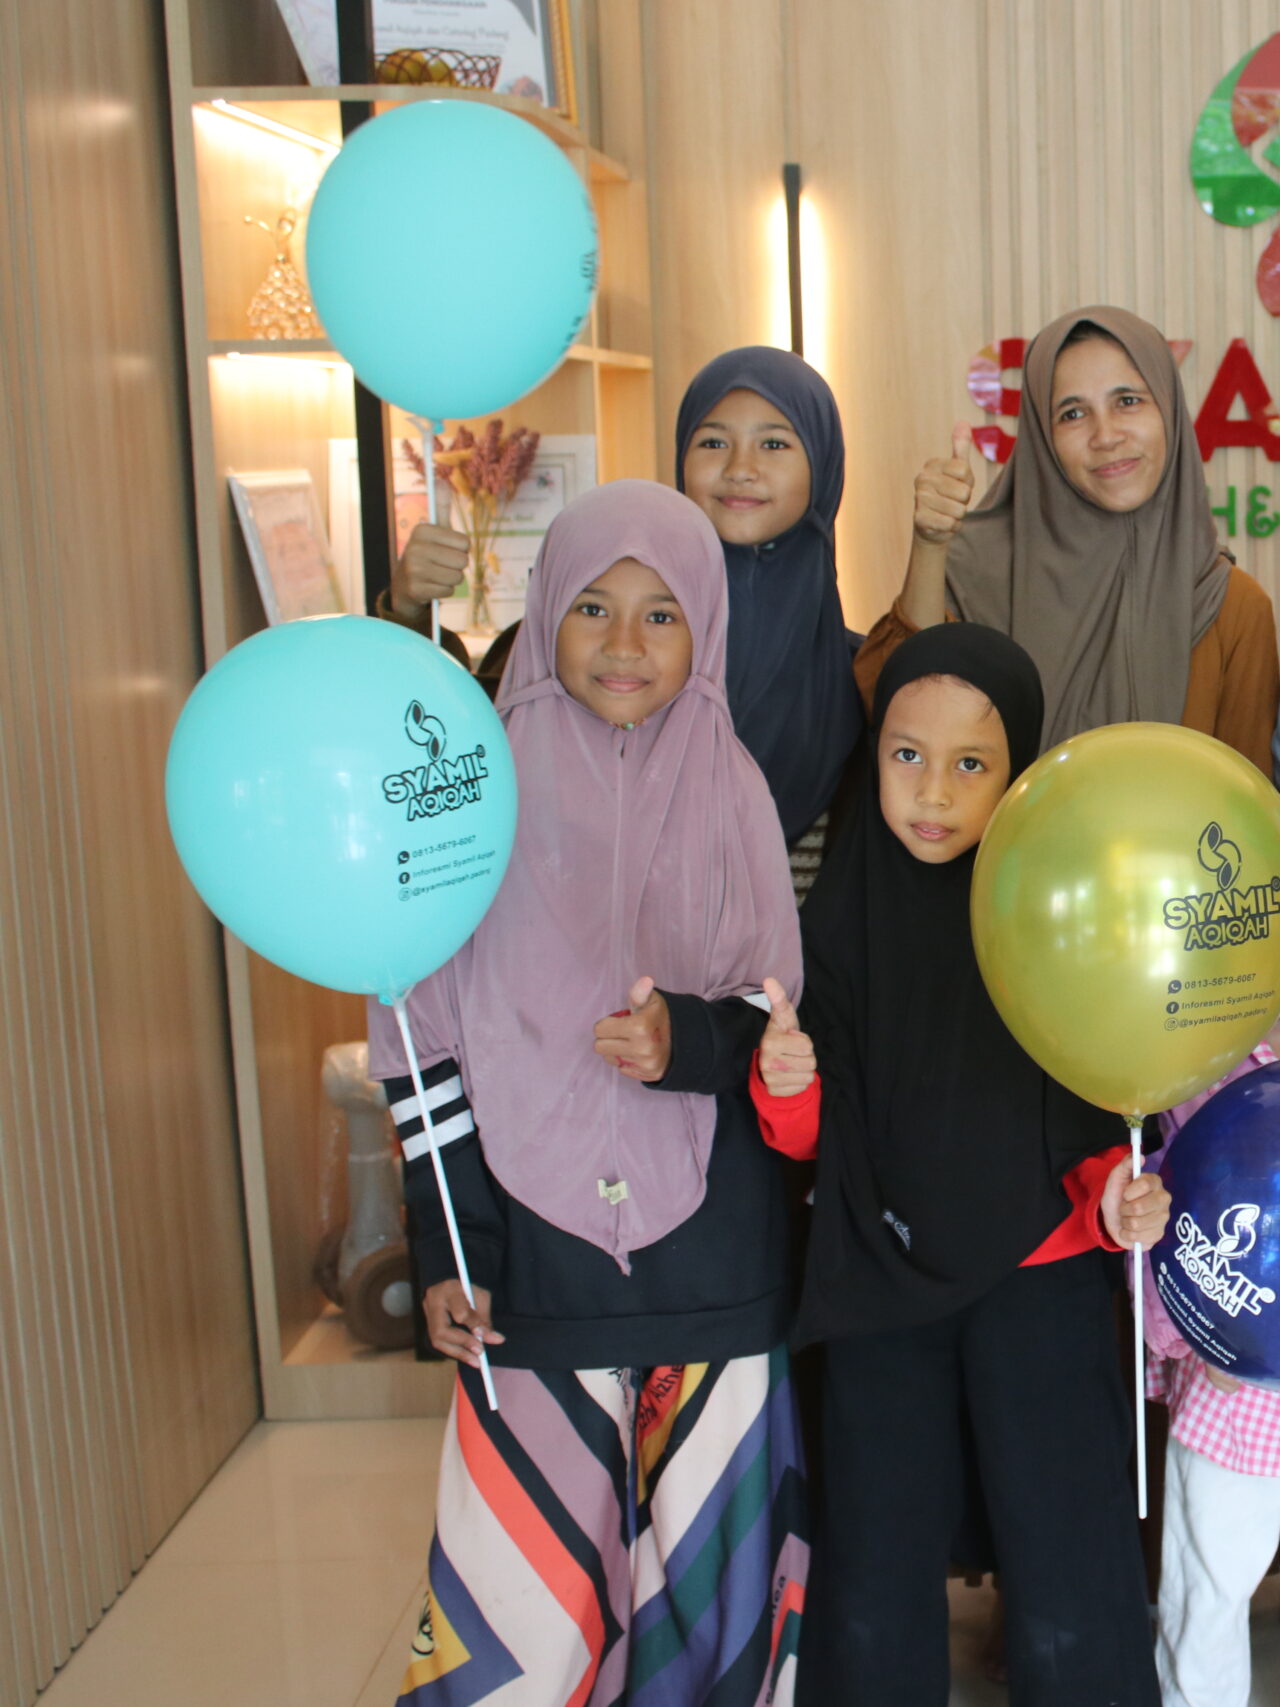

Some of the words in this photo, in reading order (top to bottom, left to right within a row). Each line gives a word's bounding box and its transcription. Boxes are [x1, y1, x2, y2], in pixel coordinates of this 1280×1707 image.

[383, 752, 488, 803] SYAMIL
[407, 780, 481, 821] AQIQAH
[1163, 884, 1280, 930] SYAMIL
[1184, 917, 1269, 950] AQIQAH
[1182, 999, 1224, 1010] Inforesmi
[1226, 994, 1253, 1006] Syamil
[1185, 973, 1256, 990] 0813-5679-6067
[1174, 1244, 1242, 1318] AQIQAH
[1176, 1212, 1262, 1316] SYAMIL
